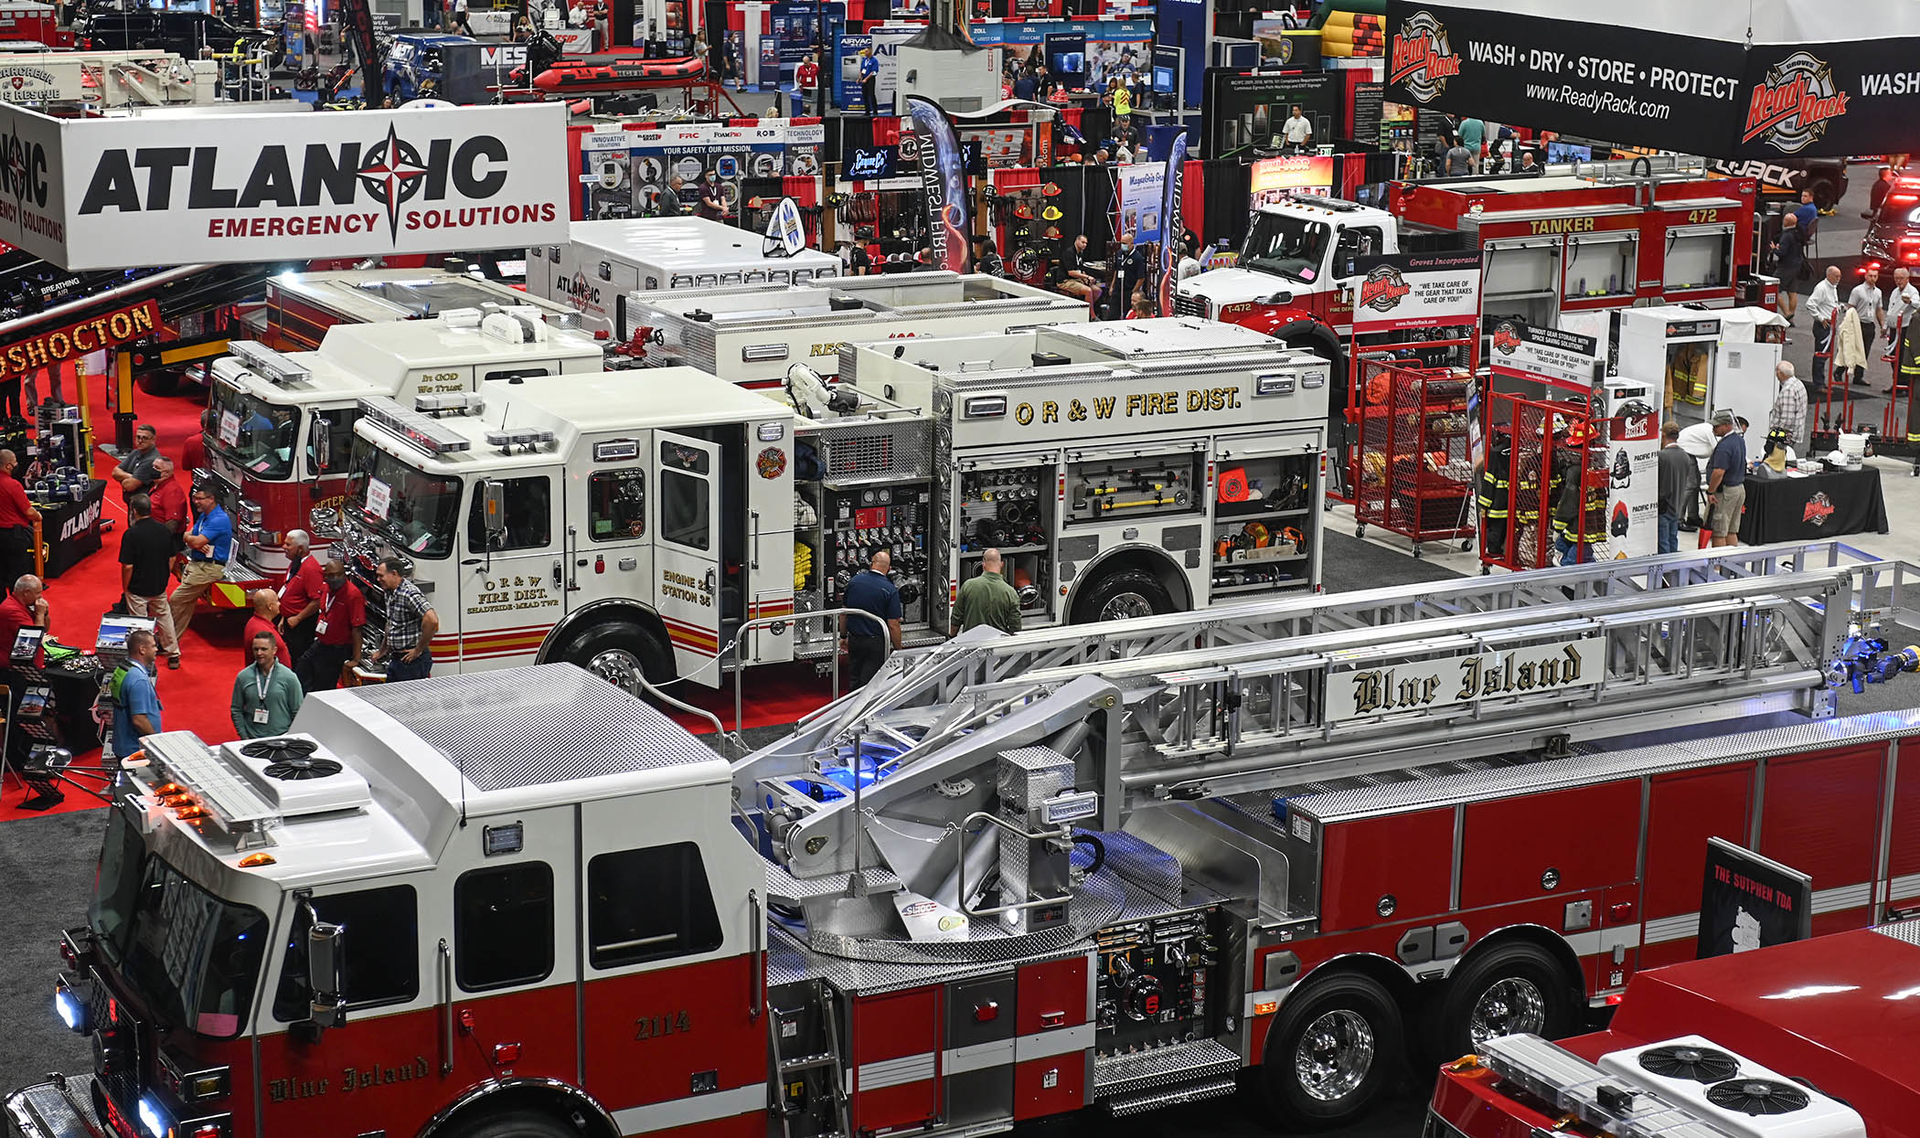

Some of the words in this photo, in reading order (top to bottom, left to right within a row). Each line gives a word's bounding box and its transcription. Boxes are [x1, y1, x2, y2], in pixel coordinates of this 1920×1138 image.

[480, 47, 527, 65] MES
[1391, 29, 1432, 75] Ready
[1425, 51, 1463, 81] Rack
[1468, 40, 1515, 66] WASH
[1530, 49, 1564, 74] DRY
[1577, 56, 1635, 85] STORE
[1650, 66, 1739, 101] PROTECT
[1861, 71, 1920, 96] WASH
[14, 88, 60, 101] RESCUE
[1526, 83, 1670, 120] www.ReadyRack.com
[1744, 72, 1811, 133] Ready
[1797, 91, 1851, 129] Rack
[592, 135, 626, 144] INNOVATIVE
[663, 147, 681, 155] YOUR
[683, 146, 707, 154] SAFETY.
[723, 144, 753, 152] MISSION.
[207, 212, 380, 239] EMERGENCY
[405, 202, 557, 230] SOLUTIONS
[1170, 170, 1183, 261] MIDWEST
[1688, 208, 1732, 225] 472
[23, 209, 63, 244] SOLUTIONS
[1530, 217, 1595, 236] TANKER
[1409, 258, 1434, 267] Groves
[1434, 256, 1479, 266] Incorporated
[41, 277, 80, 295] BREATHING
[57, 289, 69, 298] AIR
[1456, 287, 1473, 295] TAKES
[1227, 302, 1252, 314] T-472
[1547, 330, 1558, 338] GEAR
[1558, 333, 1577, 343] STORAGE
[1560, 340, 1584, 351] SOLUTIONS
[1537, 355, 1548, 363] TAKES
[1549, 358, 1560, 366] CARE
[1544, 350, 1555, 358] CARE
[1569, 355, 1579, 364] GEAR
[1580, 358, 1590, 366] THAT
[422, 374, 433, 382] In
[435, 373, 458, 381] GOD
[435, 384, 463, 392] Trust
[1015, 402, 1034, 425] O
[1042, 401, 1059, 424] R
[1067, 398, 1087, 422] &
[1093, 396, 1117, 419] W
[1126, 391, 1179, 417] FIRE
[1186, 387, 1242, 412] DIST.
[1634, 453, 1651, 462] PACIFIC
[1632, 504, 1649, 513] PACIFIC
[485, 581, 496, 591] O
[500, 578, 510, 588] R
[514, 576, 524, 587] &
[528, 576, 541, 587] W
[663, 570, 696, 588] ENGINE
[478, 592, 509, 604] FIRE
[514, 588, 548, 601] DIST.
[662, 584, 697, 604] STATION
[700, 594, 711, 608] 35
[1352, 668, 1441, 715] Blue
[1455, 643, 1583, 701] Island
[1715, 864, 1731, 884] THE
[1733, 873, 1773, 903] SUTPHEN
[1776, 890, 1792, 912] TDA
[635, 1009, 691, 1041] 2114
[270, 1077, 330, 1102] Blue
[342, 1056, 429, 1092] Island
